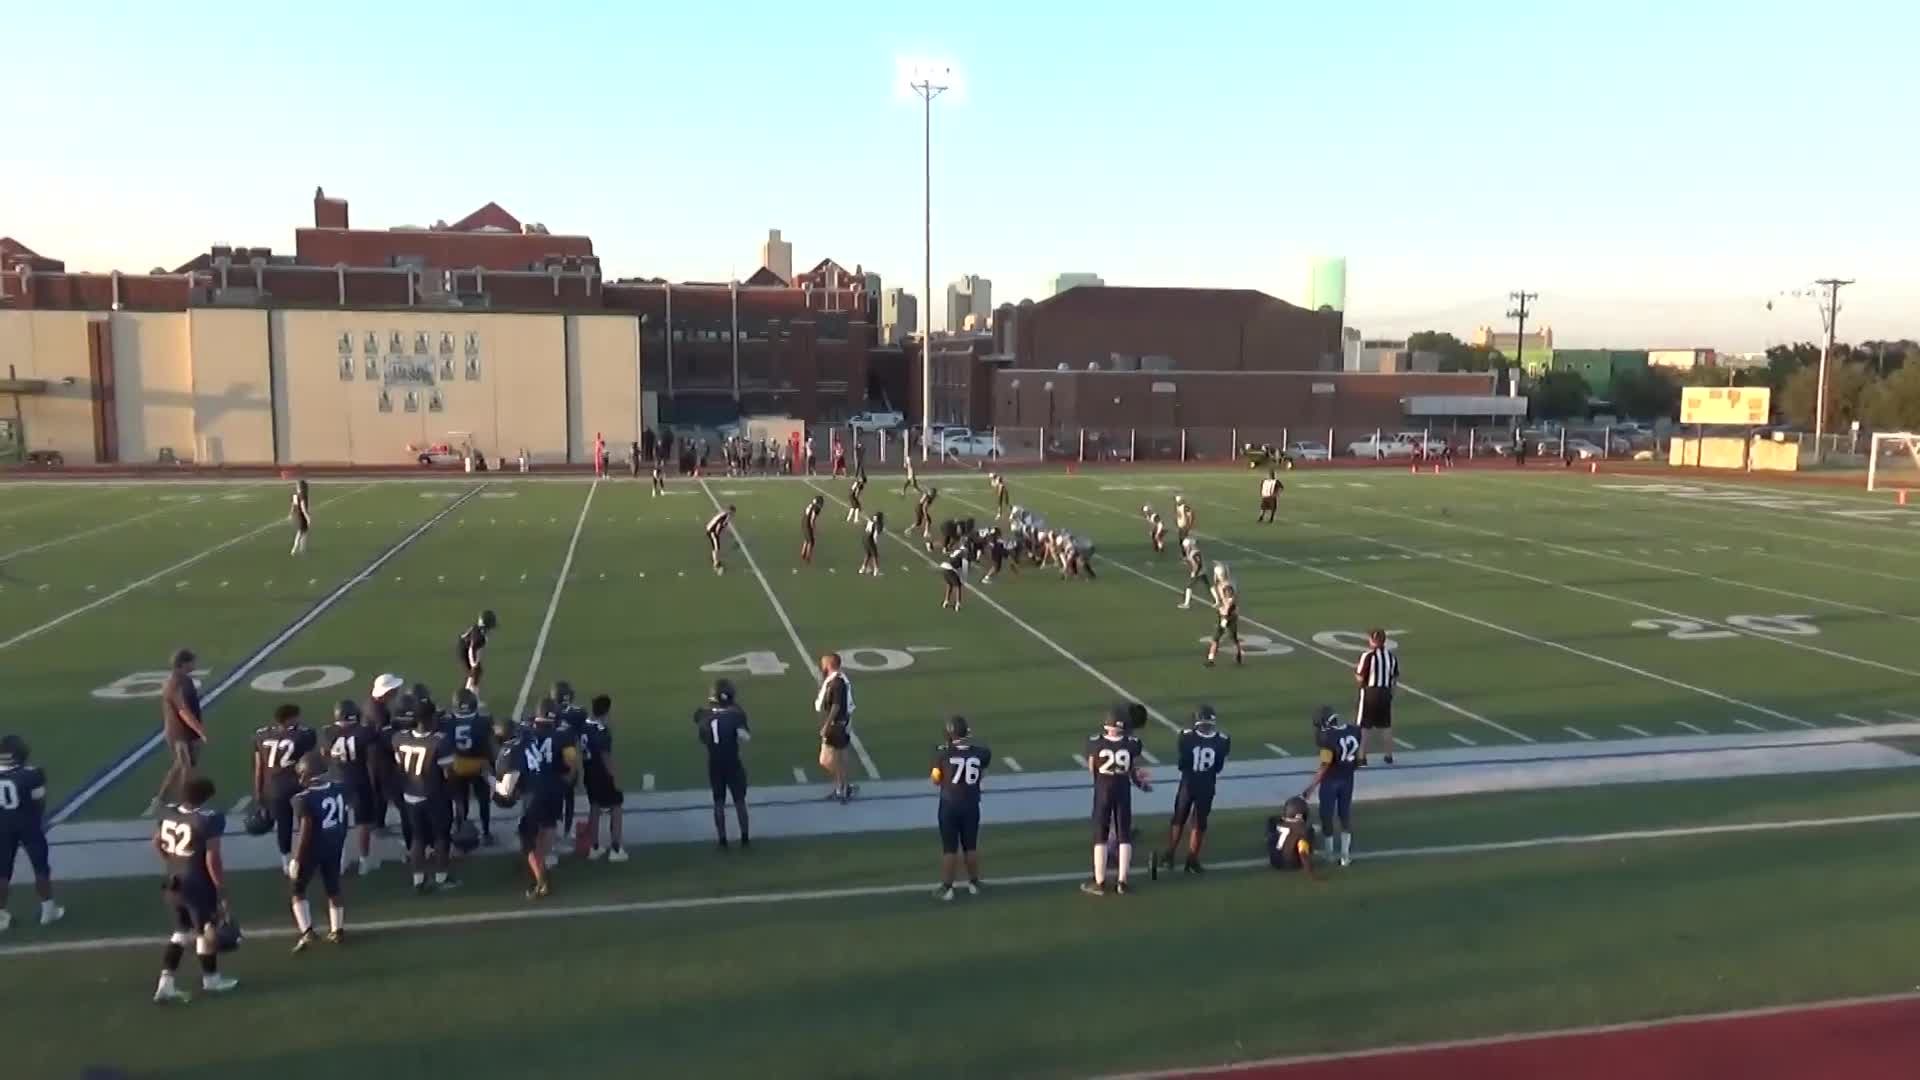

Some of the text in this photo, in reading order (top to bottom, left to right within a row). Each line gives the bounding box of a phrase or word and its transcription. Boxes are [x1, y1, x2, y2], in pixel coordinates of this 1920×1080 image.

[455, 725, 473, 750] 5
[709, 719, 720, 744] 1
[262, 738, 296, 769] 72
[330, 735, 356, 762] 41
[399, 744, 427, 777] 77
[1098, 748, 1131, 775] 29
[1191, 746, 1216, 772] 18
[1339, 735, 1360, 763] 12
[949, 757, 981, 785] 76
[321, 793, 345, 830] 21
[159, 819, 194, 858] 52
[1276, 825, 1291, 850] 7
